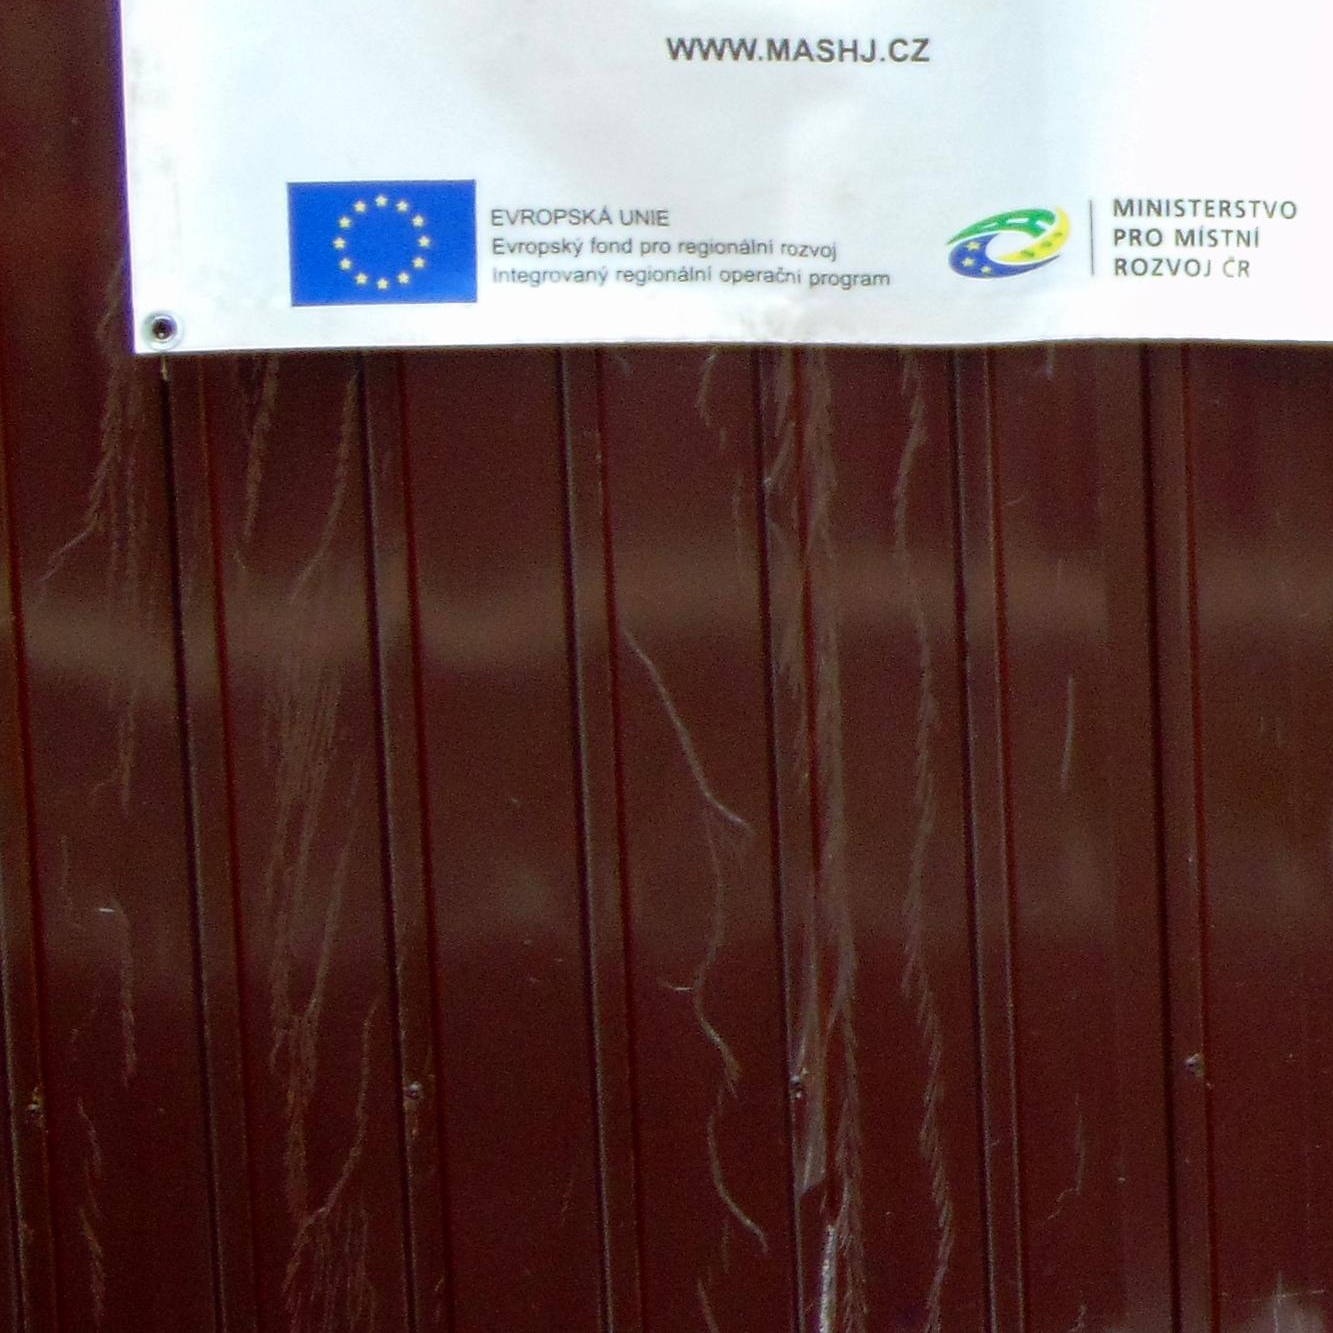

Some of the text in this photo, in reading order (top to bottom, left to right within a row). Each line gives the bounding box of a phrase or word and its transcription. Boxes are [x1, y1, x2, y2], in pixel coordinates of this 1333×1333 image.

[666, 37, 931, 63] WWW.MASHJ.CZ
[491, 206, 670, 227] EVROPSKÁ UNIE
[1113, 198, 1298, 220] MINISTERSTVO
[1113, 225, 1260, 248] PRO MÍSTNÍ
[492, 237, 837, 262] Evropský fond pro regionální rozvoj
[1114, 255, 1250, 278] ROZVOJ ČR
[492, 266, 891, 291] Integrovaný regionální operační program
